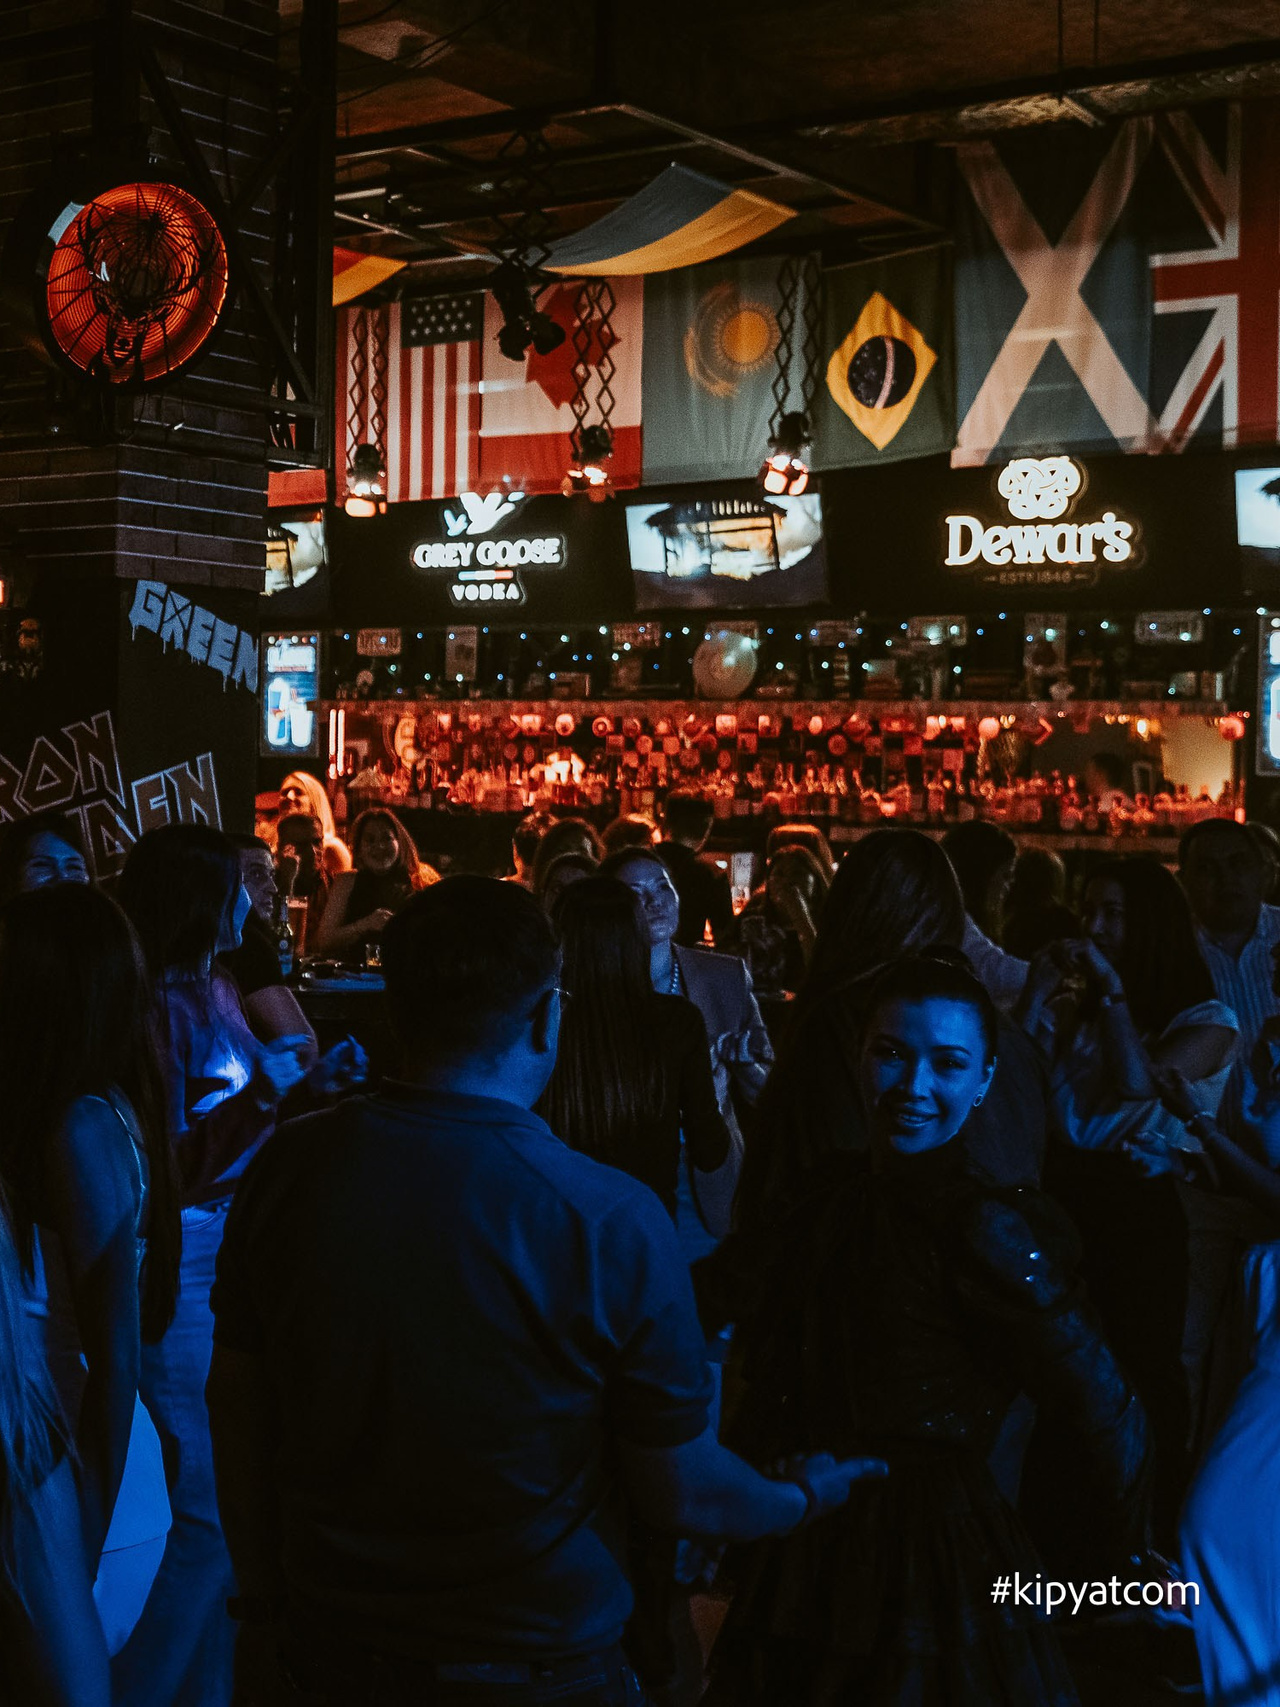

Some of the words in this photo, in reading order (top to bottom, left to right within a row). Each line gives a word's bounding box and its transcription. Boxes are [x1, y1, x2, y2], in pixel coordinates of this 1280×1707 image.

[413, 542, 474, 568] GREY
[476, 538, 560, 566] GOOSE
[945, 512, 1133, 565] Dewar's
[452, 583, 520, 600] VODKA
[128, 579, 260, 694] GREEN
